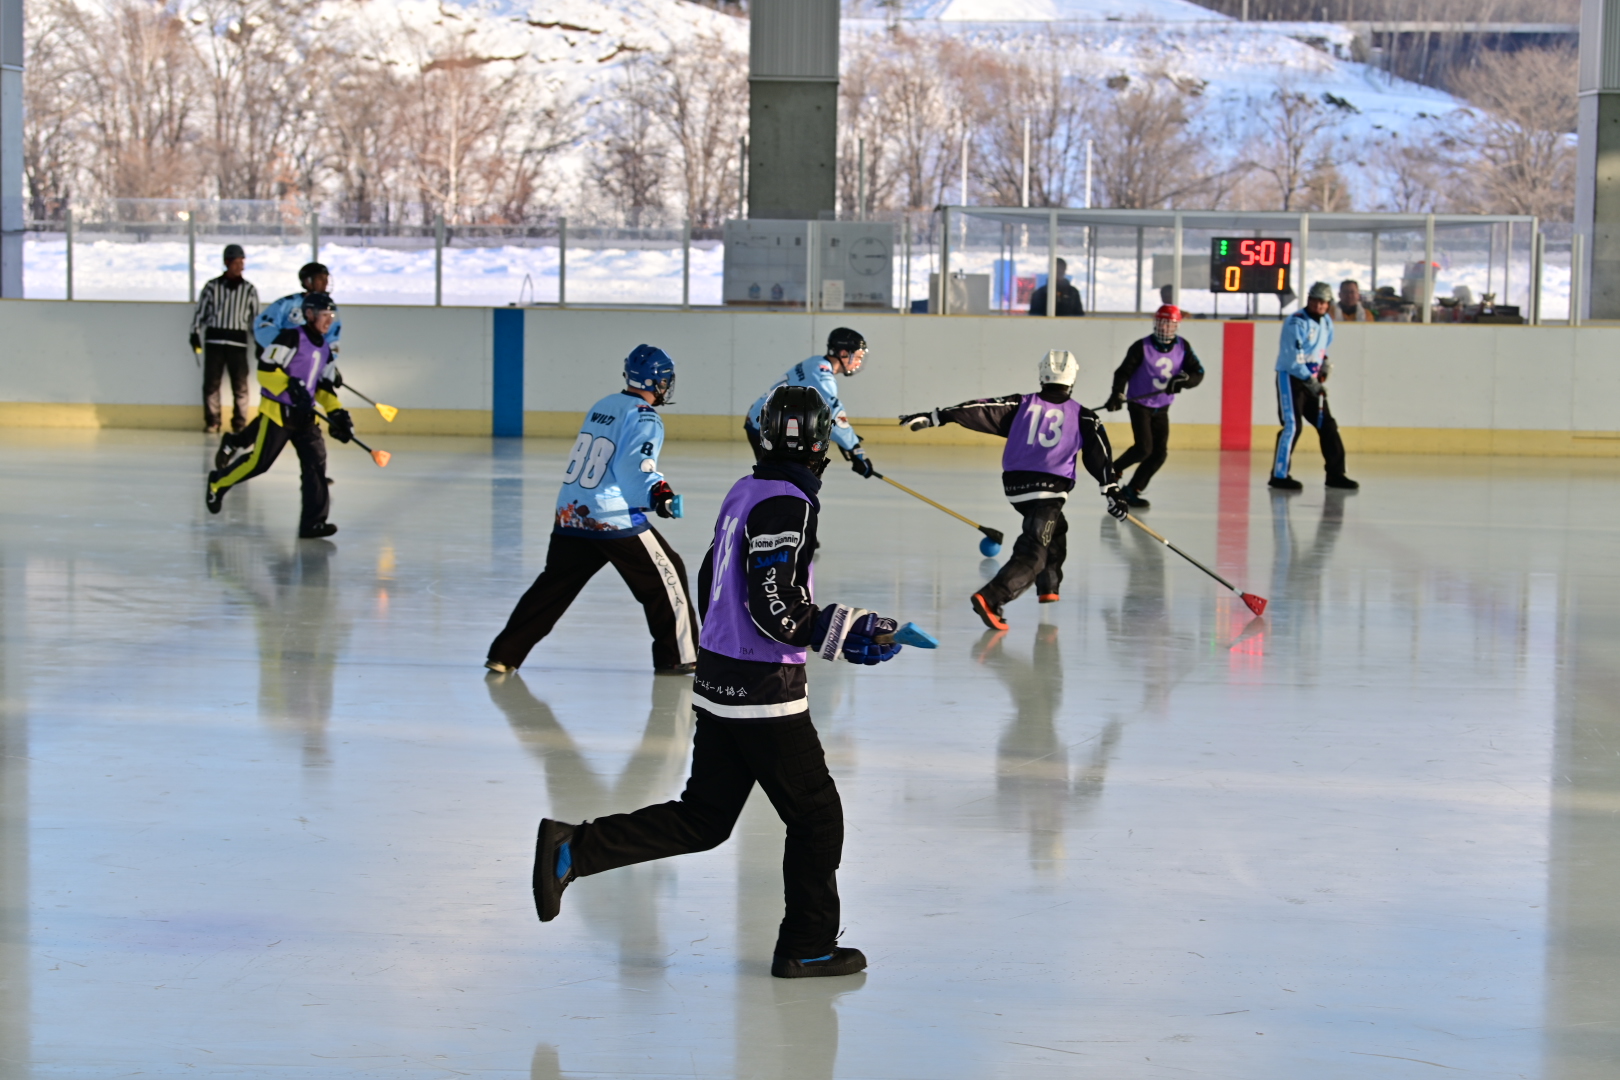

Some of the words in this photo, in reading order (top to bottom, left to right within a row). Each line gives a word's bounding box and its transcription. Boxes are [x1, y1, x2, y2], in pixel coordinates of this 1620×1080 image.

[1240, 240, 1291, 266] 5:01
[1224, 266, 1241, 291] 0
[1277, 267, 1285, 291] 1
[307, 350, 321, 389] 1
[1152, 357, 1174, 390] 3
[1026, 404, 1066, 447] 13
[562, 431, 617, 490] 88
[655, 551, 684, 607] ACACIA
